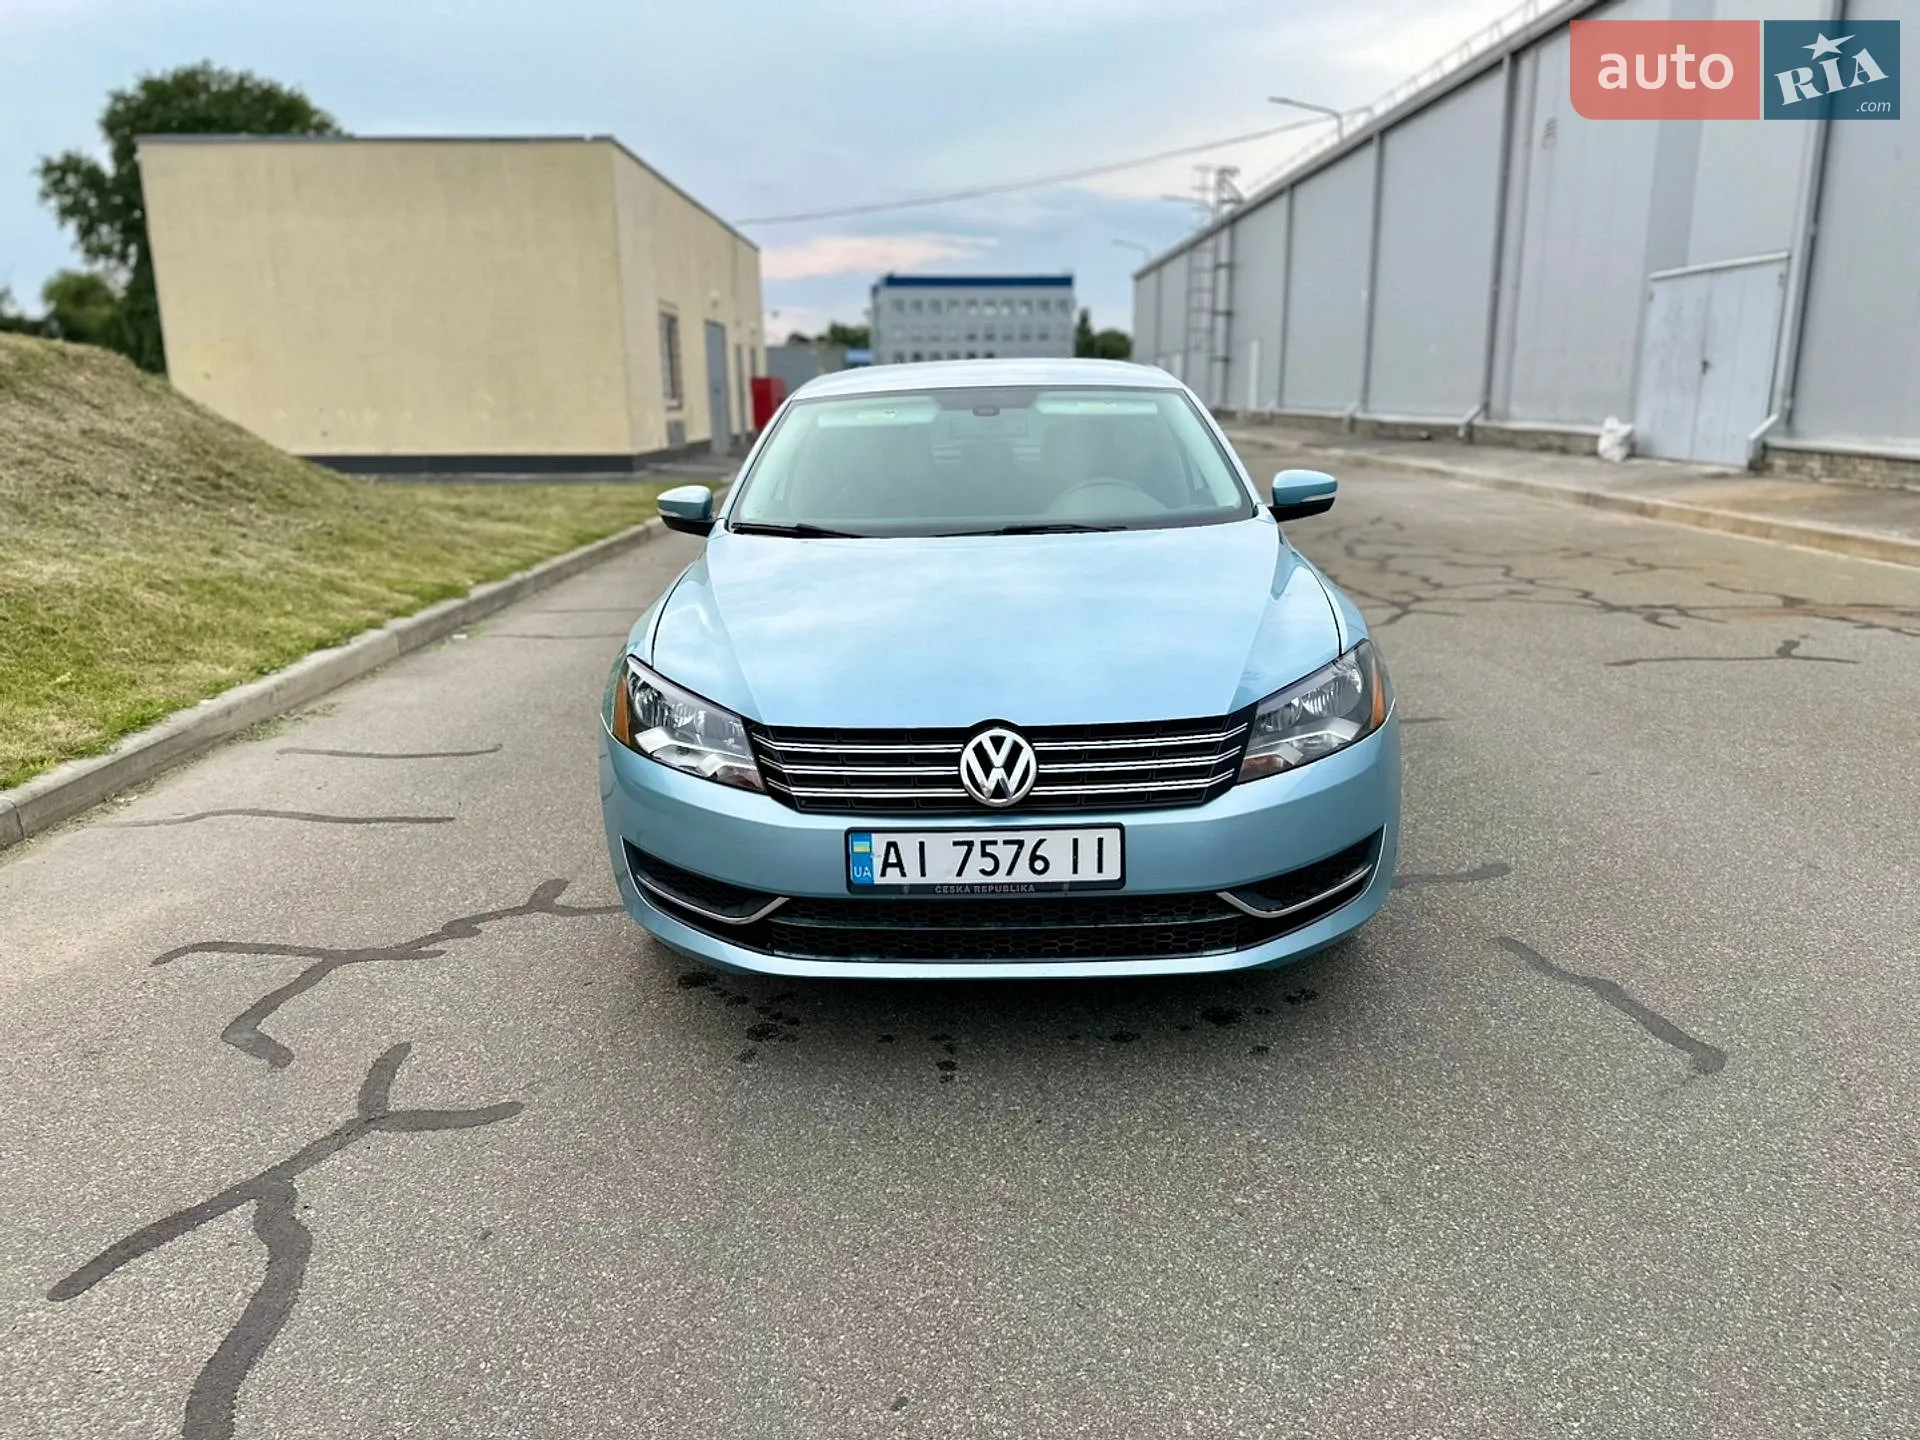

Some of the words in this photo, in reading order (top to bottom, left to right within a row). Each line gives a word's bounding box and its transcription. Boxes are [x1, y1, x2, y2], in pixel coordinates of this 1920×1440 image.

[880, 841, 927, 878] AI
[952, 839, 1050, 877] 7576
[1072, 837, 1104, 875] II
[853, 866, 872, 878] UA
[973, 884, 1036, 894] REPUBLIKA
